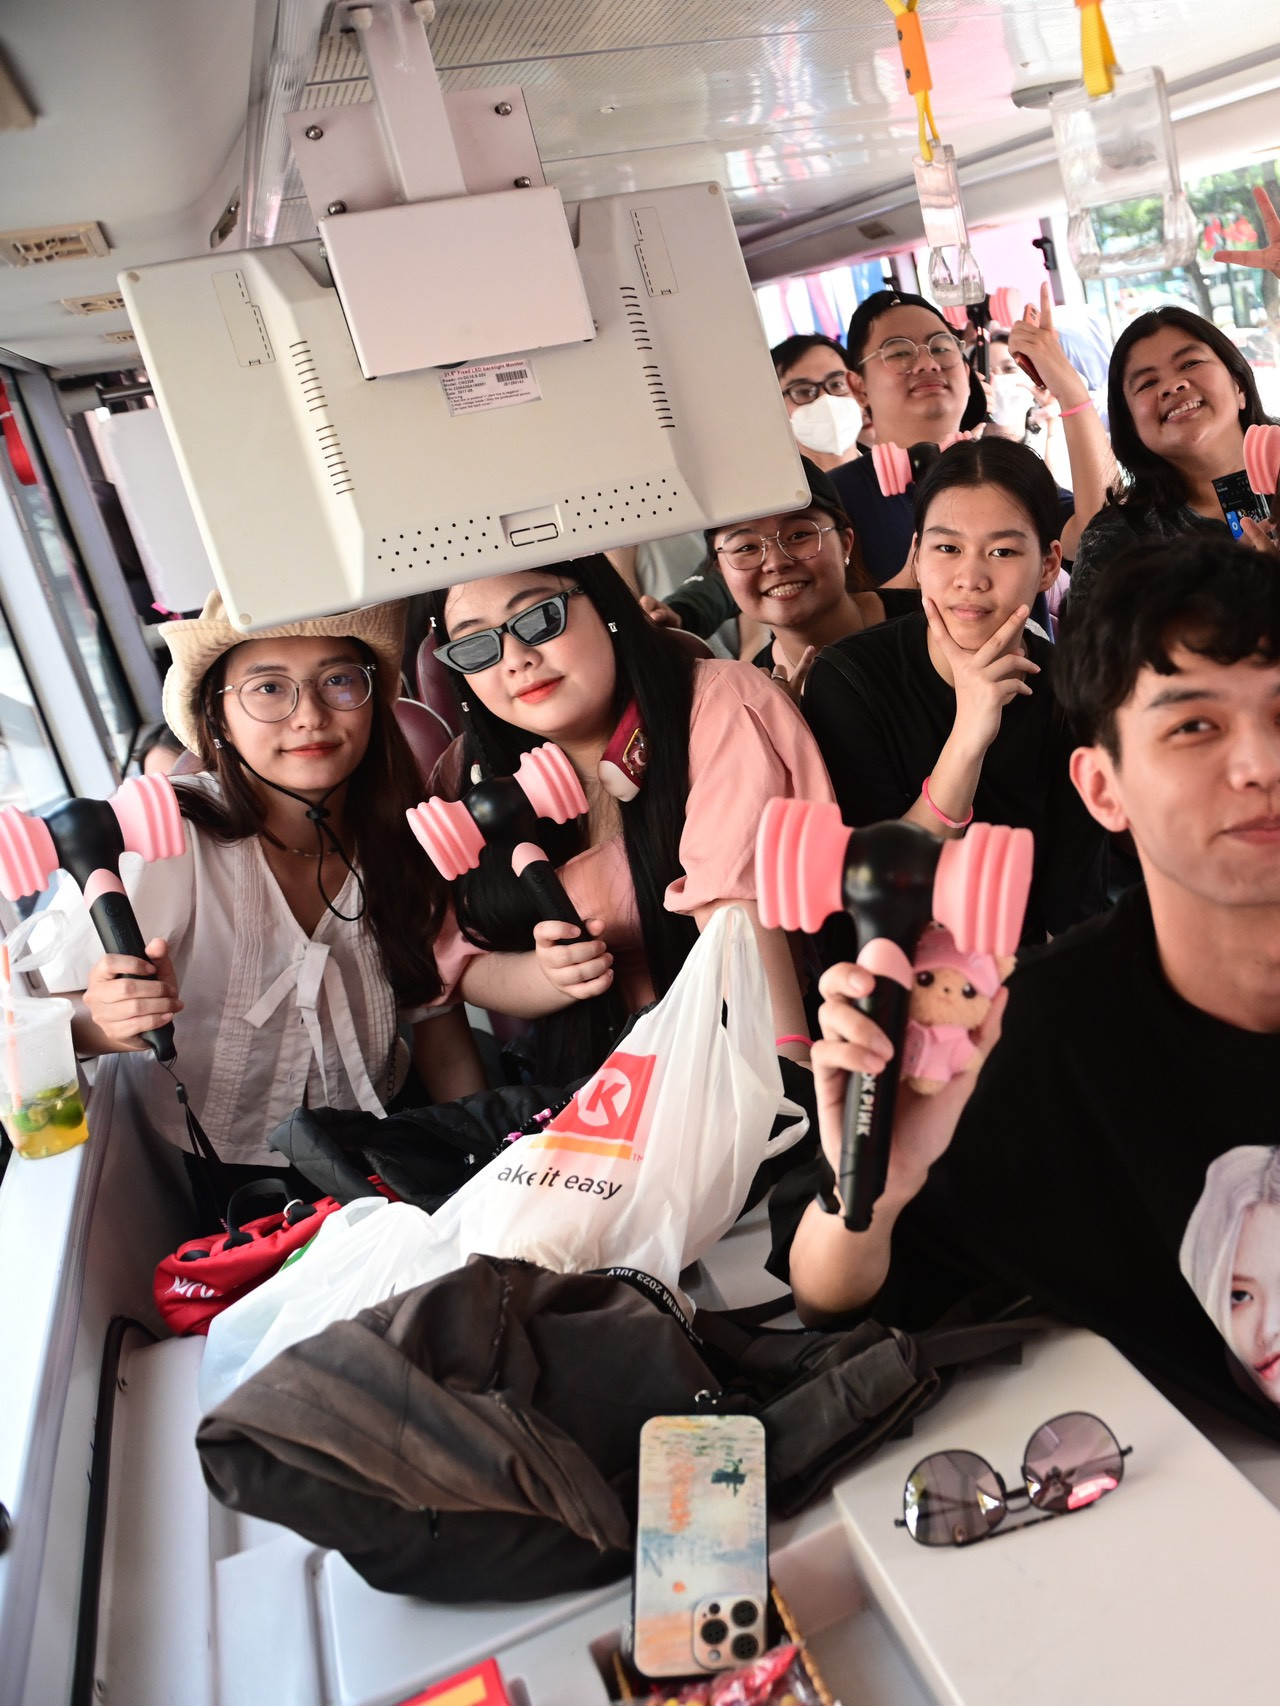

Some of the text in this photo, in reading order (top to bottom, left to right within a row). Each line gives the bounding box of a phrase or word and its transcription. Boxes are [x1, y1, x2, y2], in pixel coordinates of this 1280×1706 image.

[472, 366, 483, 374] LED
[506, 361, 524, 369] Monitor
[539, 1166, 560, 1188] it
[564, 1174, 623, 1201] easy
[606, 1267, 686, 1323] ARENA 2023 JULY
